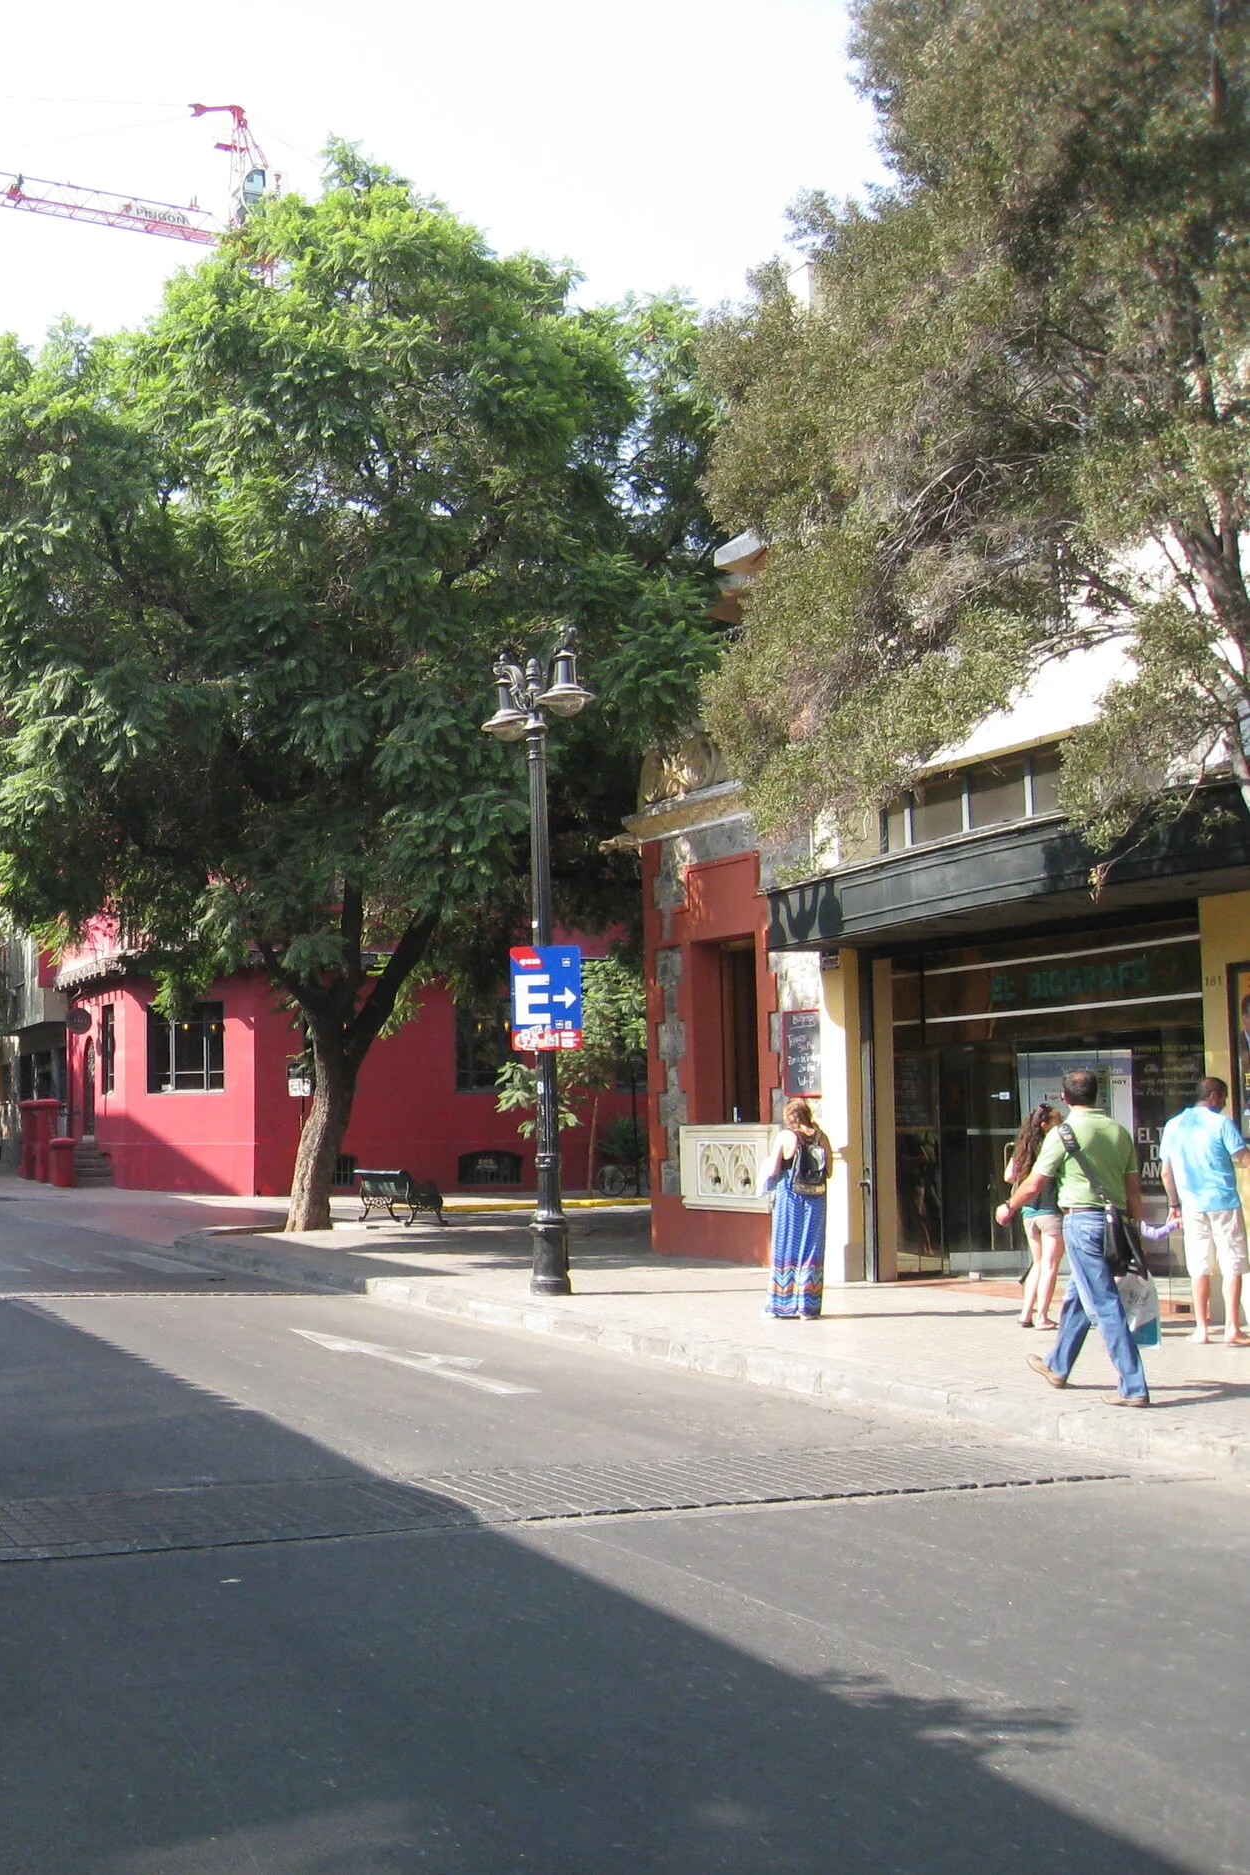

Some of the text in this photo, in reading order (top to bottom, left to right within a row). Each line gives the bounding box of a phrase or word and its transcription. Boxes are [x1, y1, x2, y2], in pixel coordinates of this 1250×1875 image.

[990, 957, 1150, 1001] EL BIOGRAFO
[514, 974, 551, 1025] E
[1137, 1127, 1154, 1143] EL
[1141, 1161, 1163, 1178] AM
